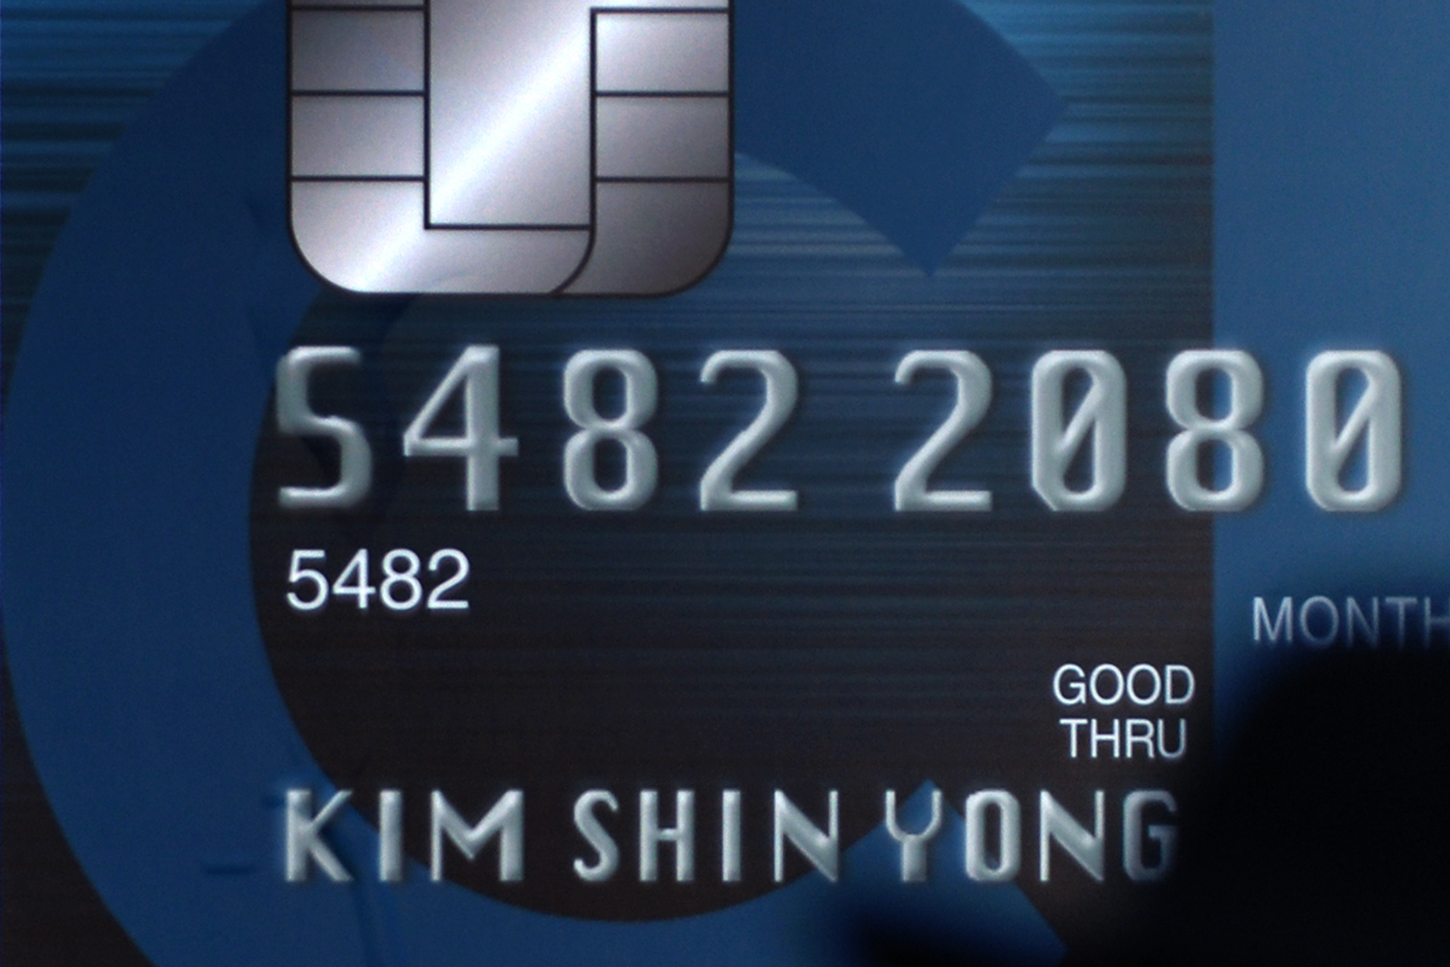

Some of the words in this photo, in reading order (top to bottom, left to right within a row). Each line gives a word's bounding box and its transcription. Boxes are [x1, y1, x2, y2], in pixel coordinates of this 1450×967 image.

[275, 343, 799, 513] 5482
[893, 348, 1404, 513] 2080
[285, 547, 471, 611] 5482
[1051, 663, 1196, 706] GOOD
[1058, 717, 1188, 760] THRU
[283, 789, 526, 884] KIM
[572, 789, 840, 884] SHIN
[884, 789, 1180, 885] YONG
